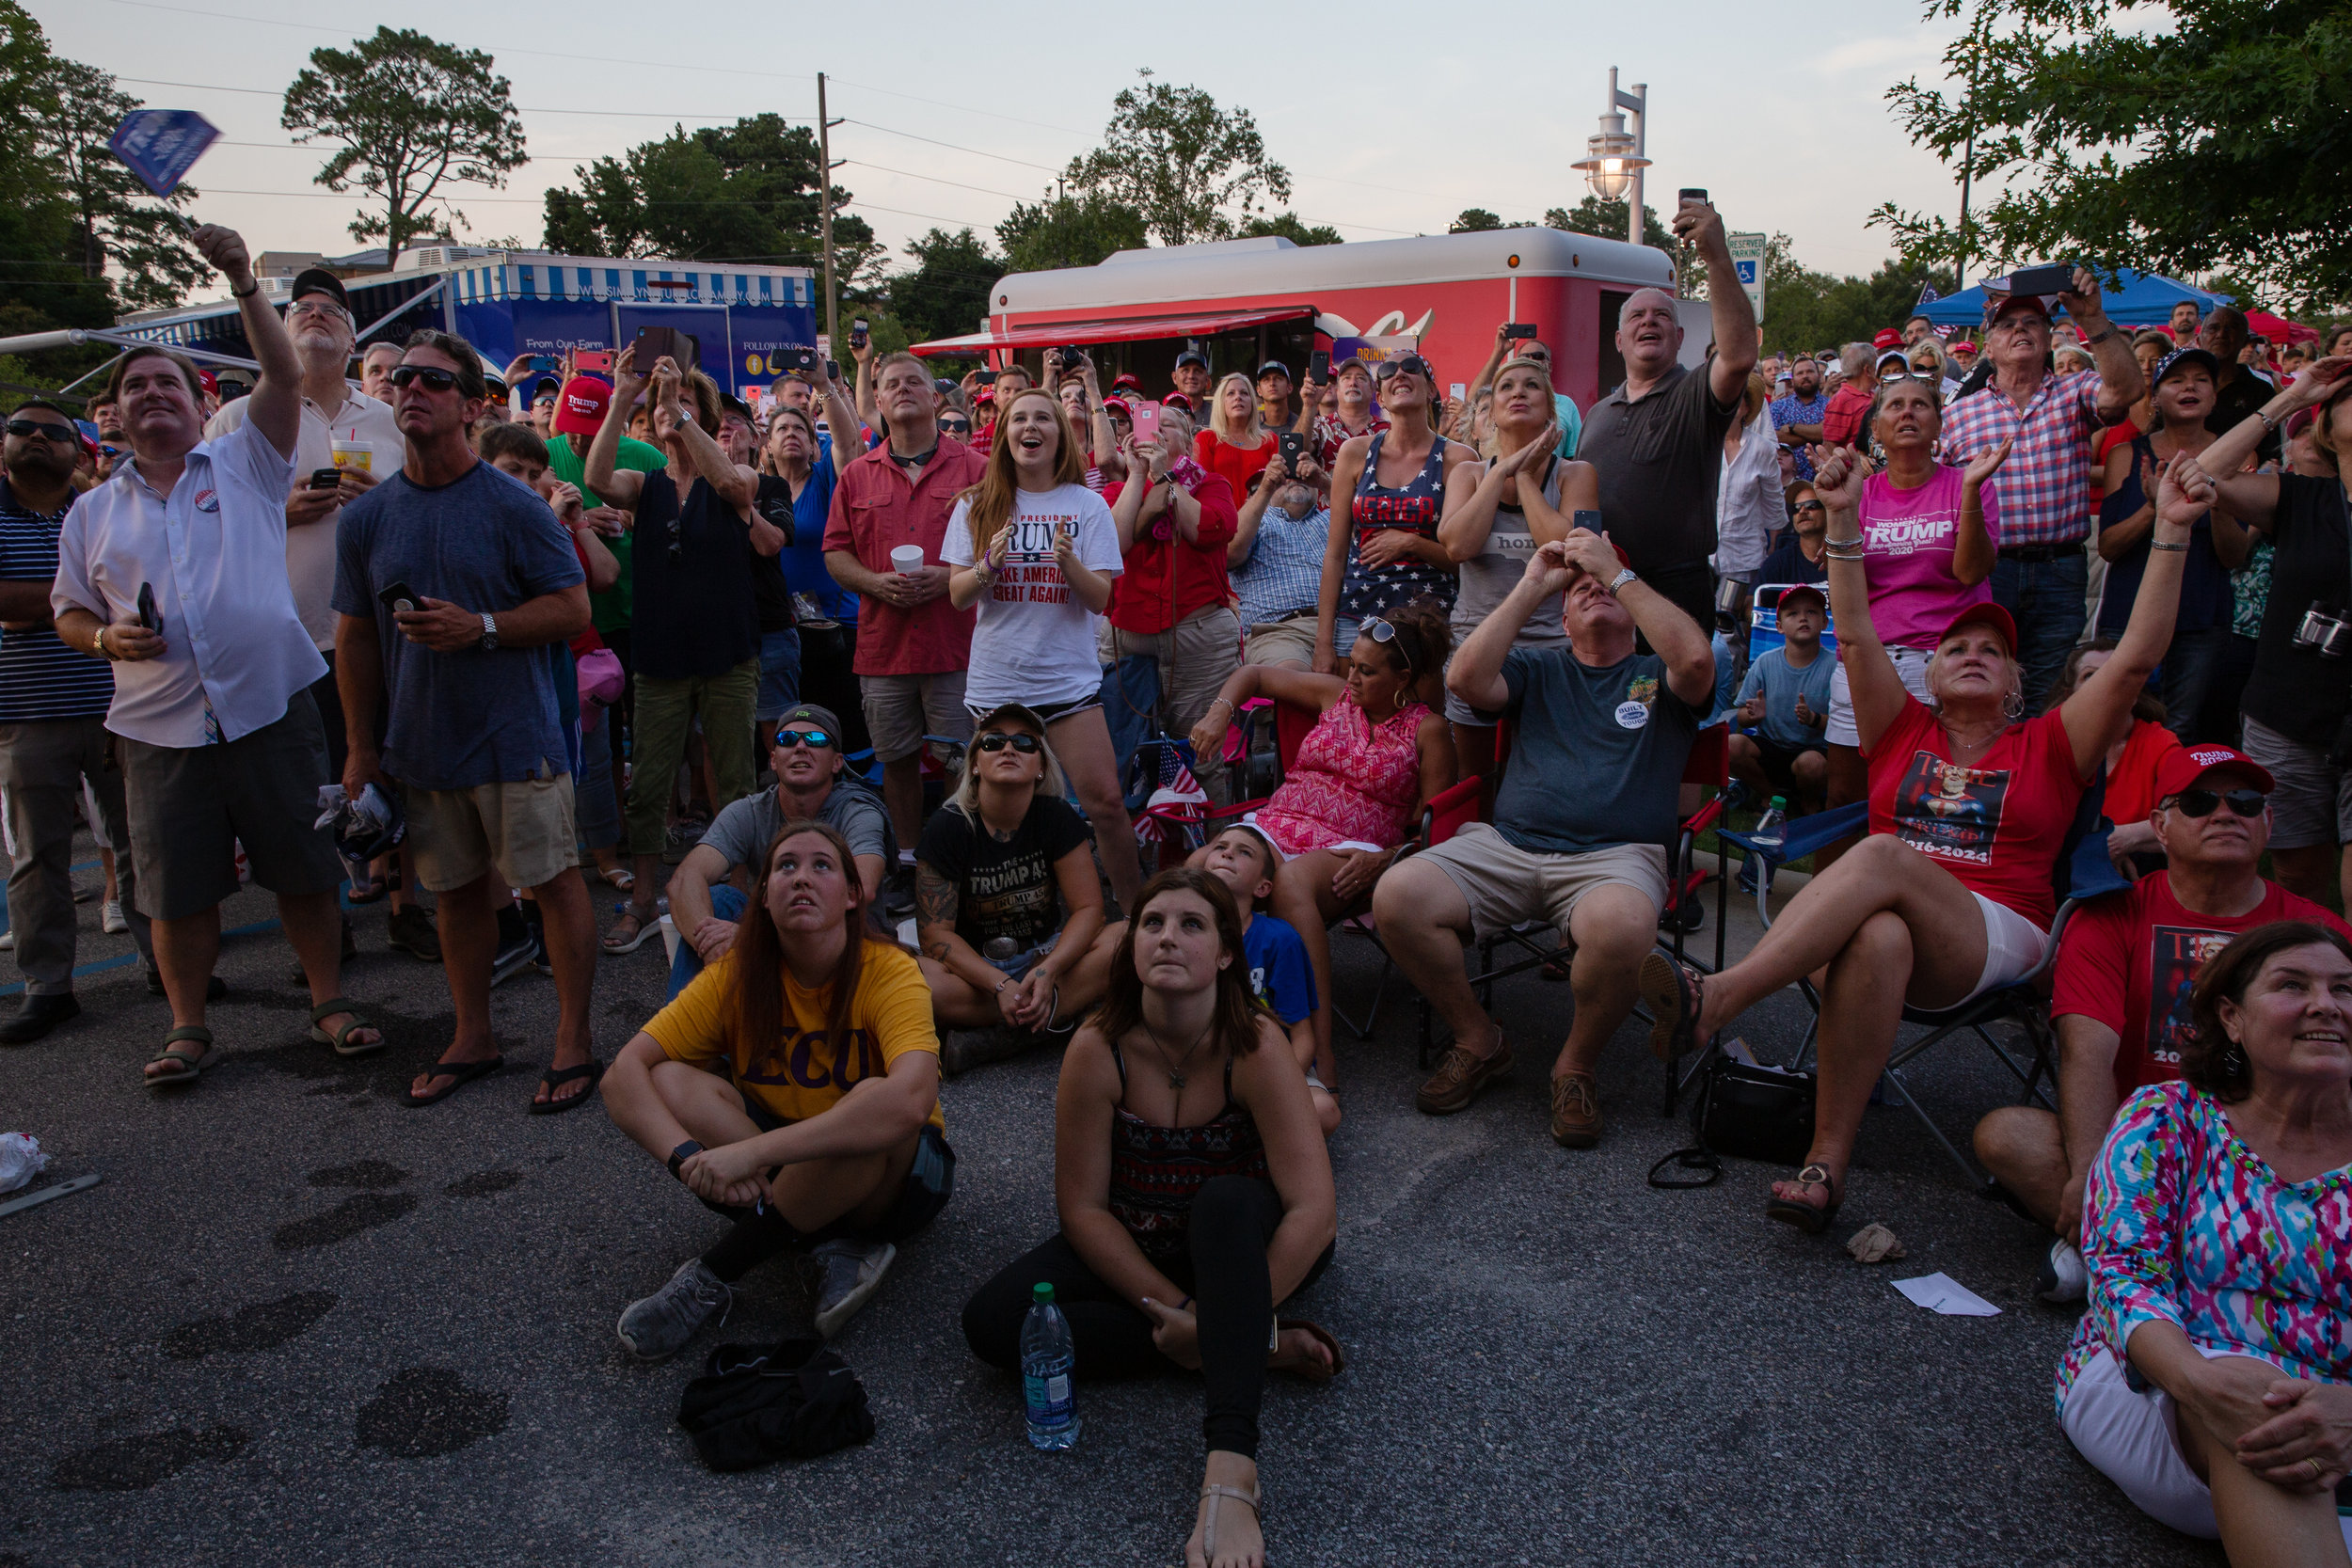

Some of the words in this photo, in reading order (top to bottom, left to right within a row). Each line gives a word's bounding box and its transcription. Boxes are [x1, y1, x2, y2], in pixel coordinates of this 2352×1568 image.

[1730, 239, 1763, 248] RESERVED
[1731, 249, 1761, 258] PARKING
[526, 339, 553, 349] From
[556, 339, 575, 349] Our
[578, 340, 604, 350] Farm
[743, 341, 778, 351] FOLLOW
[790, 342, 803, 351] ON
[568, 394, 598, 410] Trump
[1877, 518, 1916, 529] WOMEN
[1009, 521, 1079, 551] RUMP
[1888, 546, 1914, 556] 2020
[993, 584, 1025, 602] GREAT
[1029, 585, 1071, 604] AGAIN!
[1618, 705, 1643, 714] BUILT
[1623, 718, 1648, 726] TOUGH
[2190, 751, 2235, 761] TRUMP
[1002, 857, 1019, 871] THE
[970, 865, 1029, 895] TRUMP
[993, 893, 1031, 908] TRUMP
[740, 1027, 870, 1092] ECU
